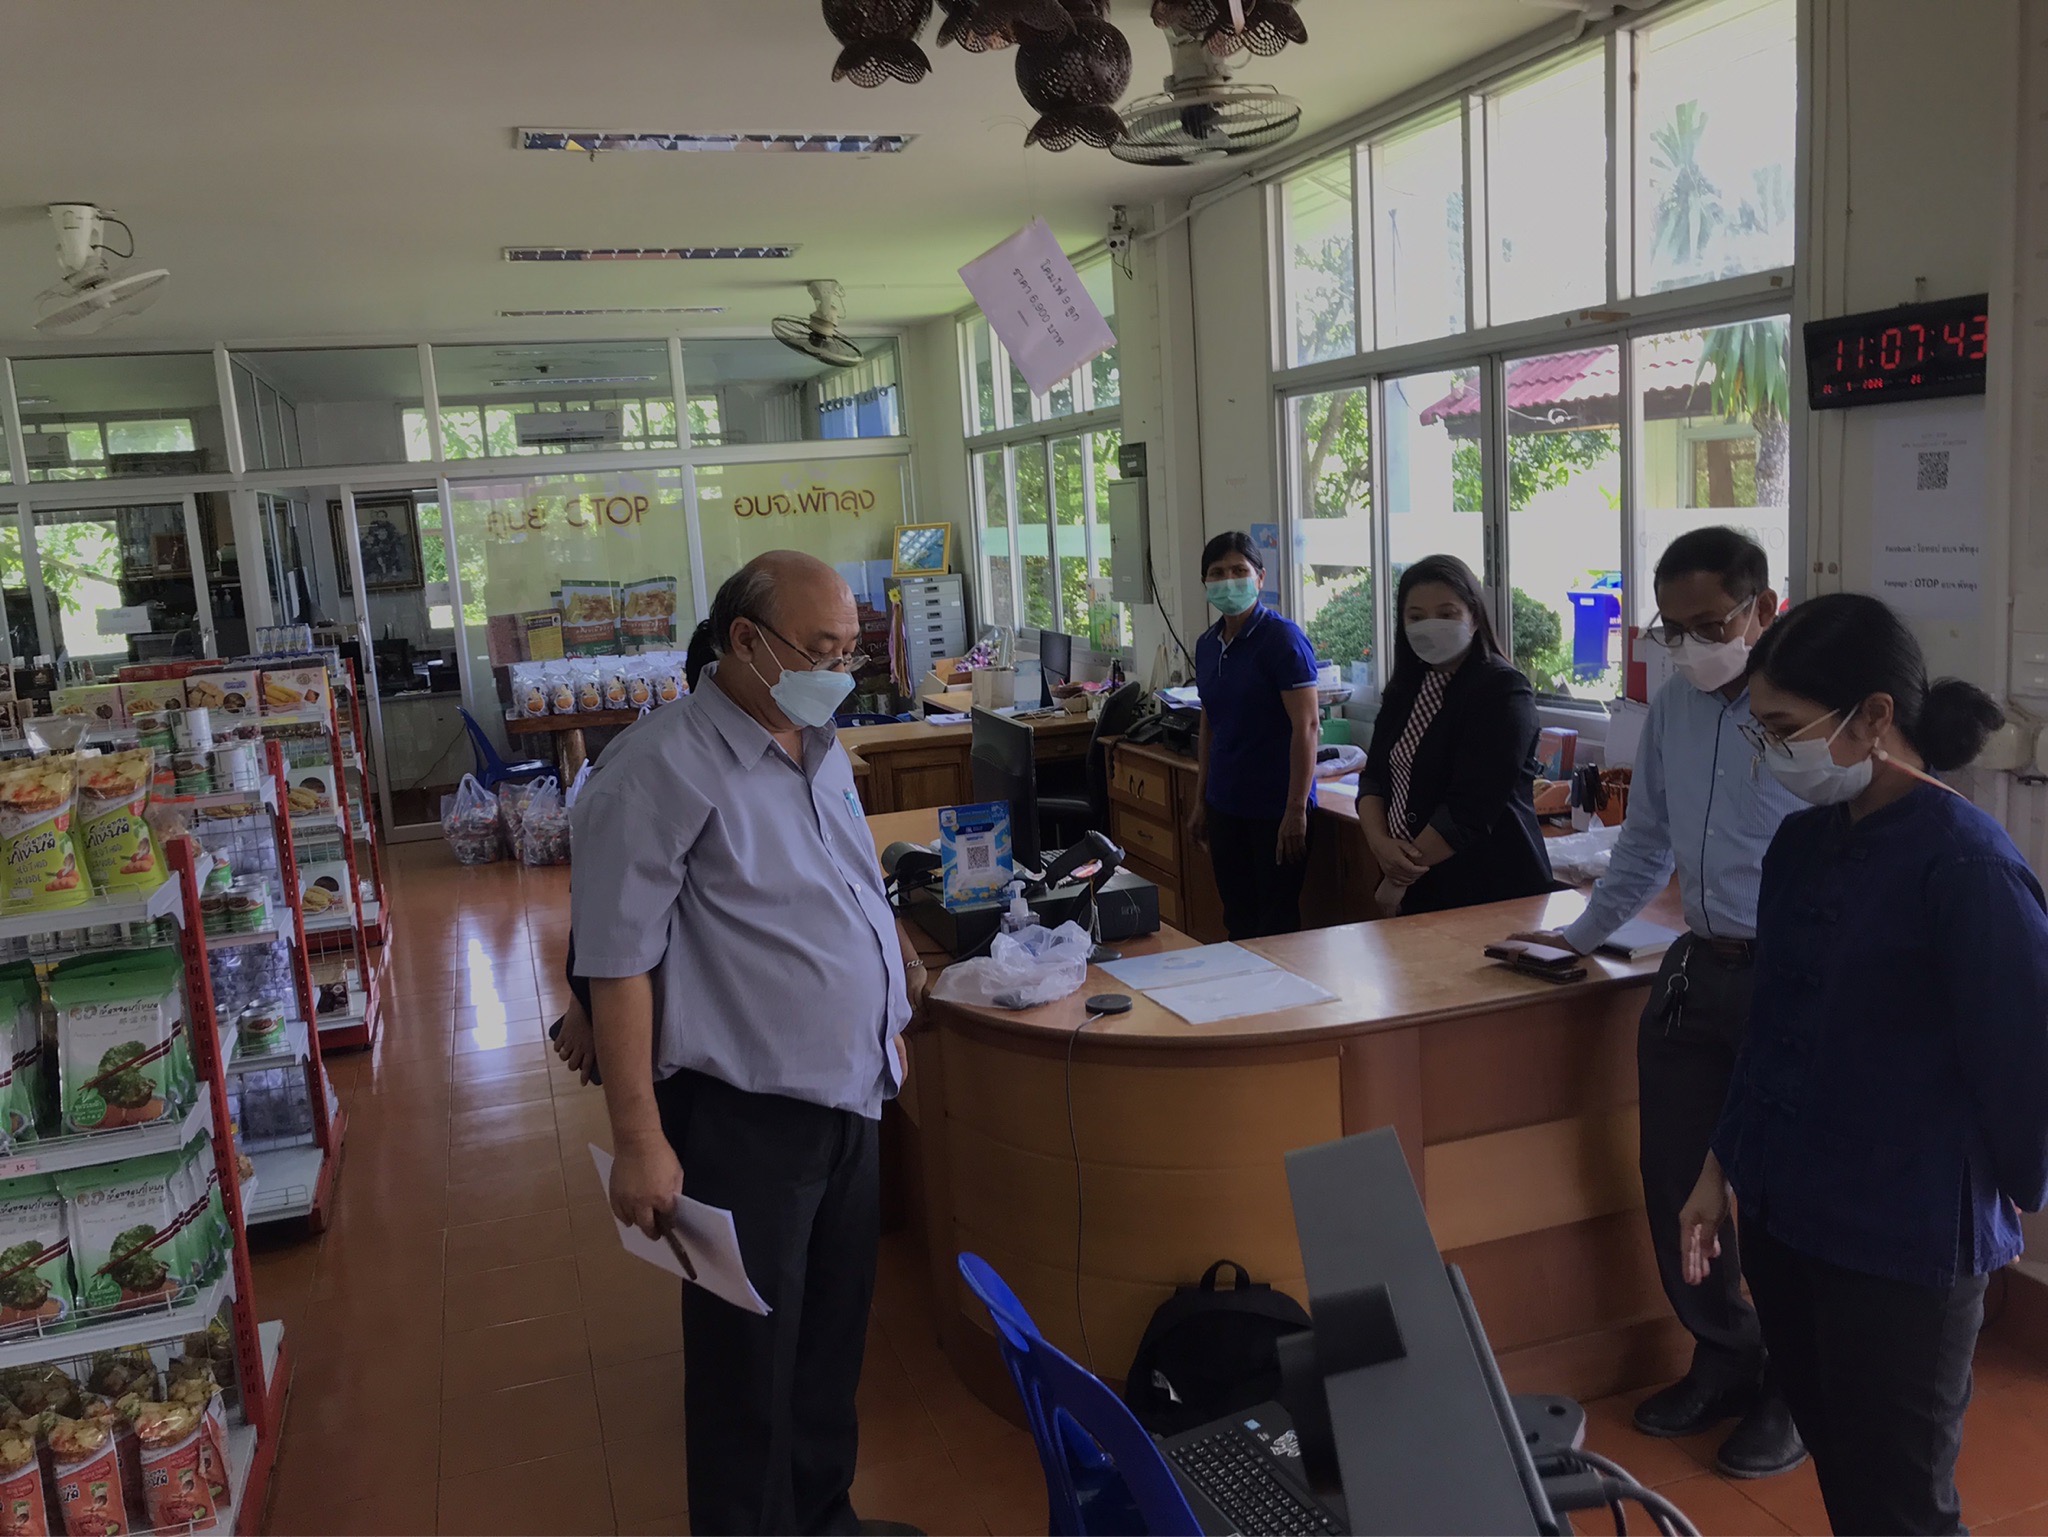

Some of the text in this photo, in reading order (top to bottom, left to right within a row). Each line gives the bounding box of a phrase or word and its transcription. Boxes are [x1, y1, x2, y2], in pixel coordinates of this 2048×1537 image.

[1013, 268, 1032, 295] ราคา
[1047, 323, 1065, 347] บาท
[1040, 258, 1080, 322] โคมไฟ 9 ลูก
[1836, 314, 1989, 373] 11:07:43
[1914, 578, 1940, 588] OTOP
